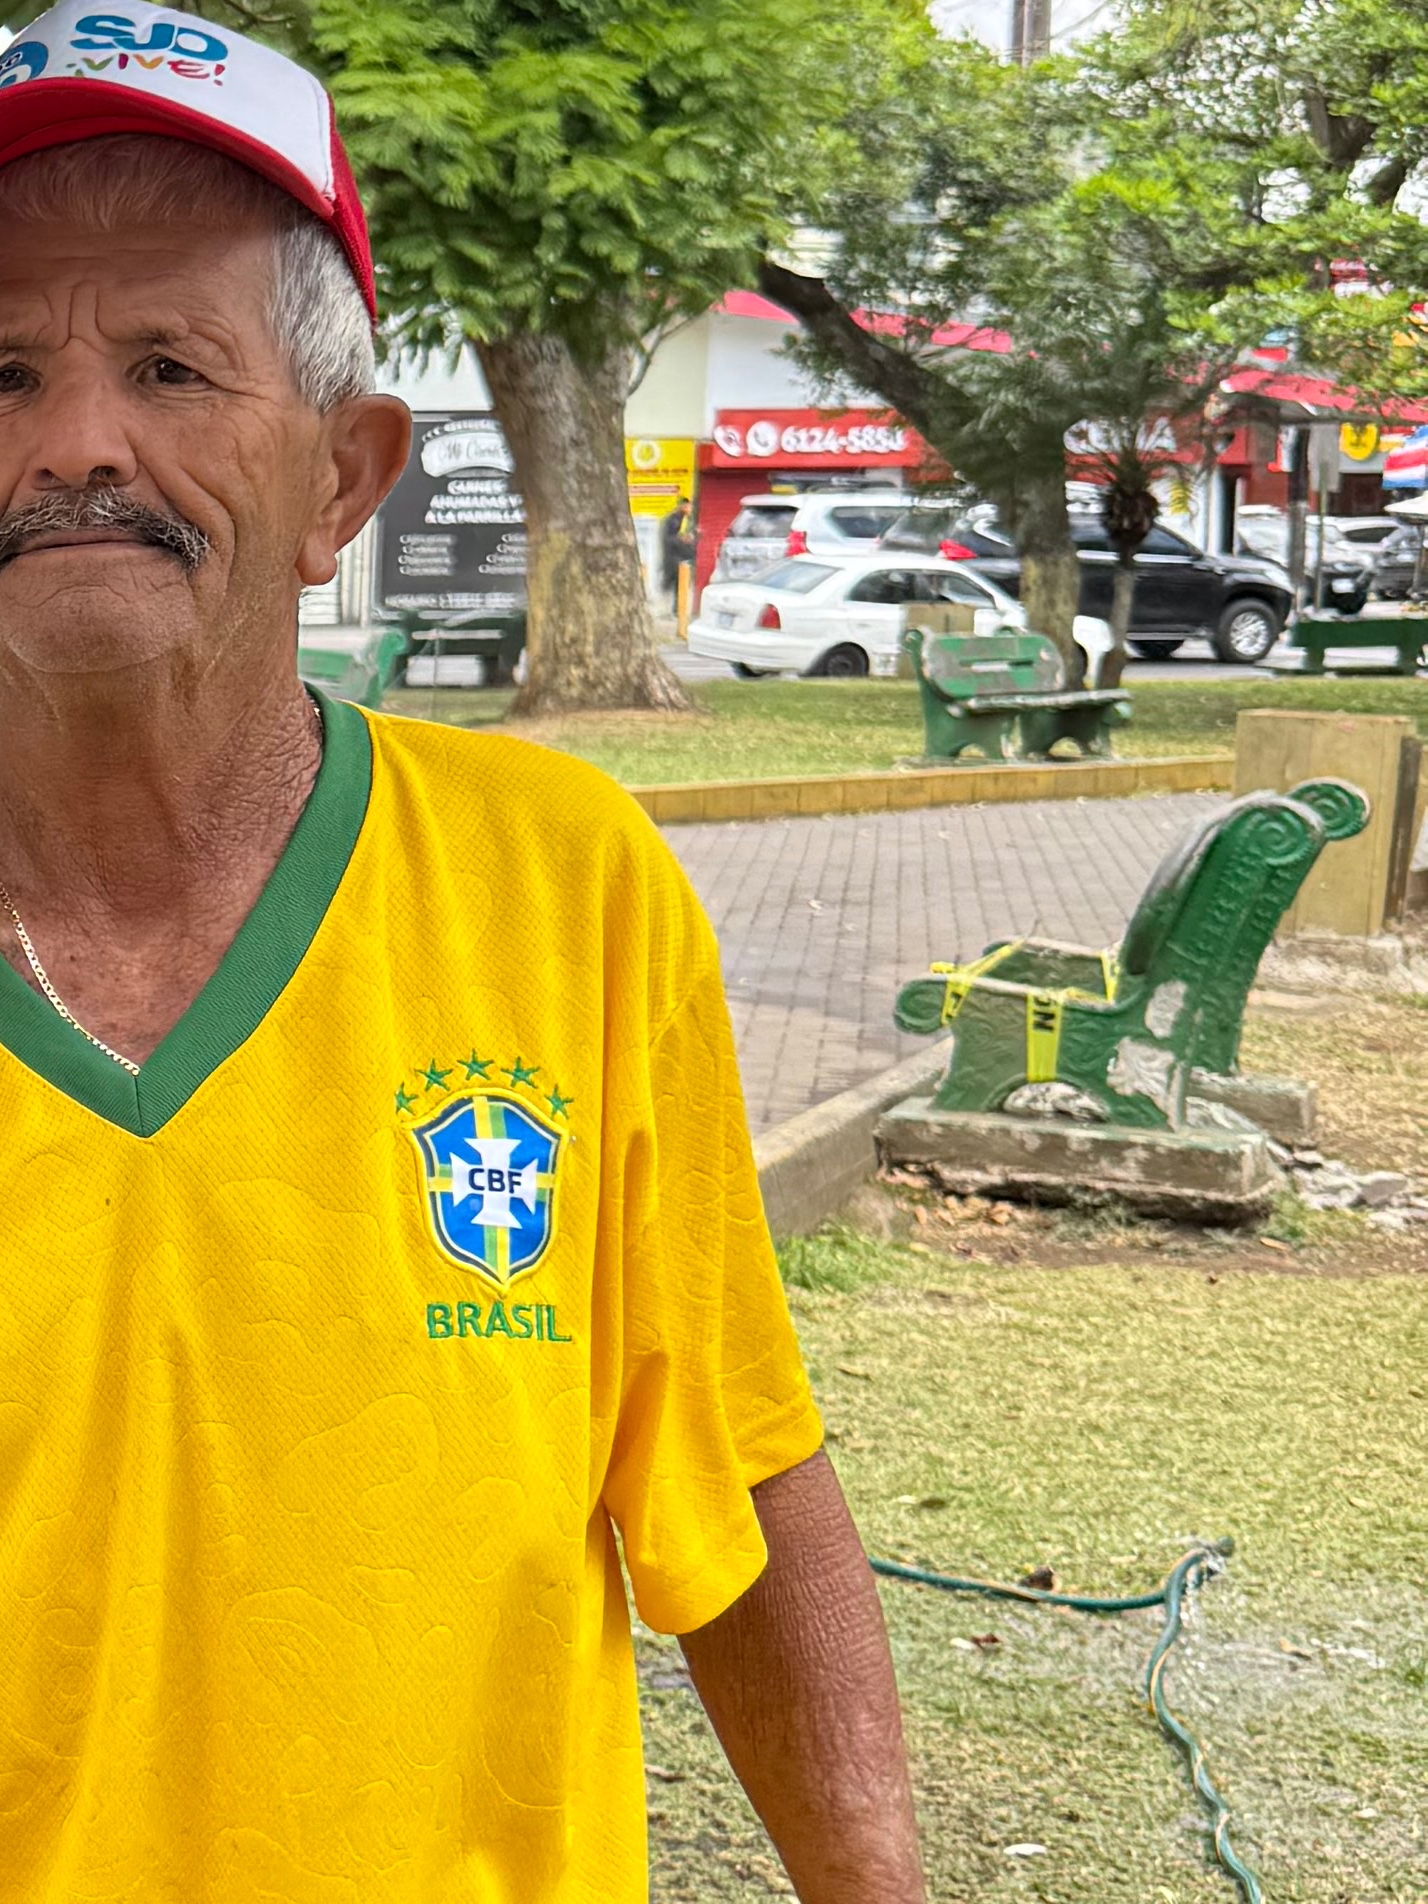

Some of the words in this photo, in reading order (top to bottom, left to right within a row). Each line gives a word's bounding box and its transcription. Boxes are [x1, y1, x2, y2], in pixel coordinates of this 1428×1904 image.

[70, 14, 229, 62] SJO
[468, 1167, 523, 1194] CBF
[426, 1299, 574, 1342] BRASIL
